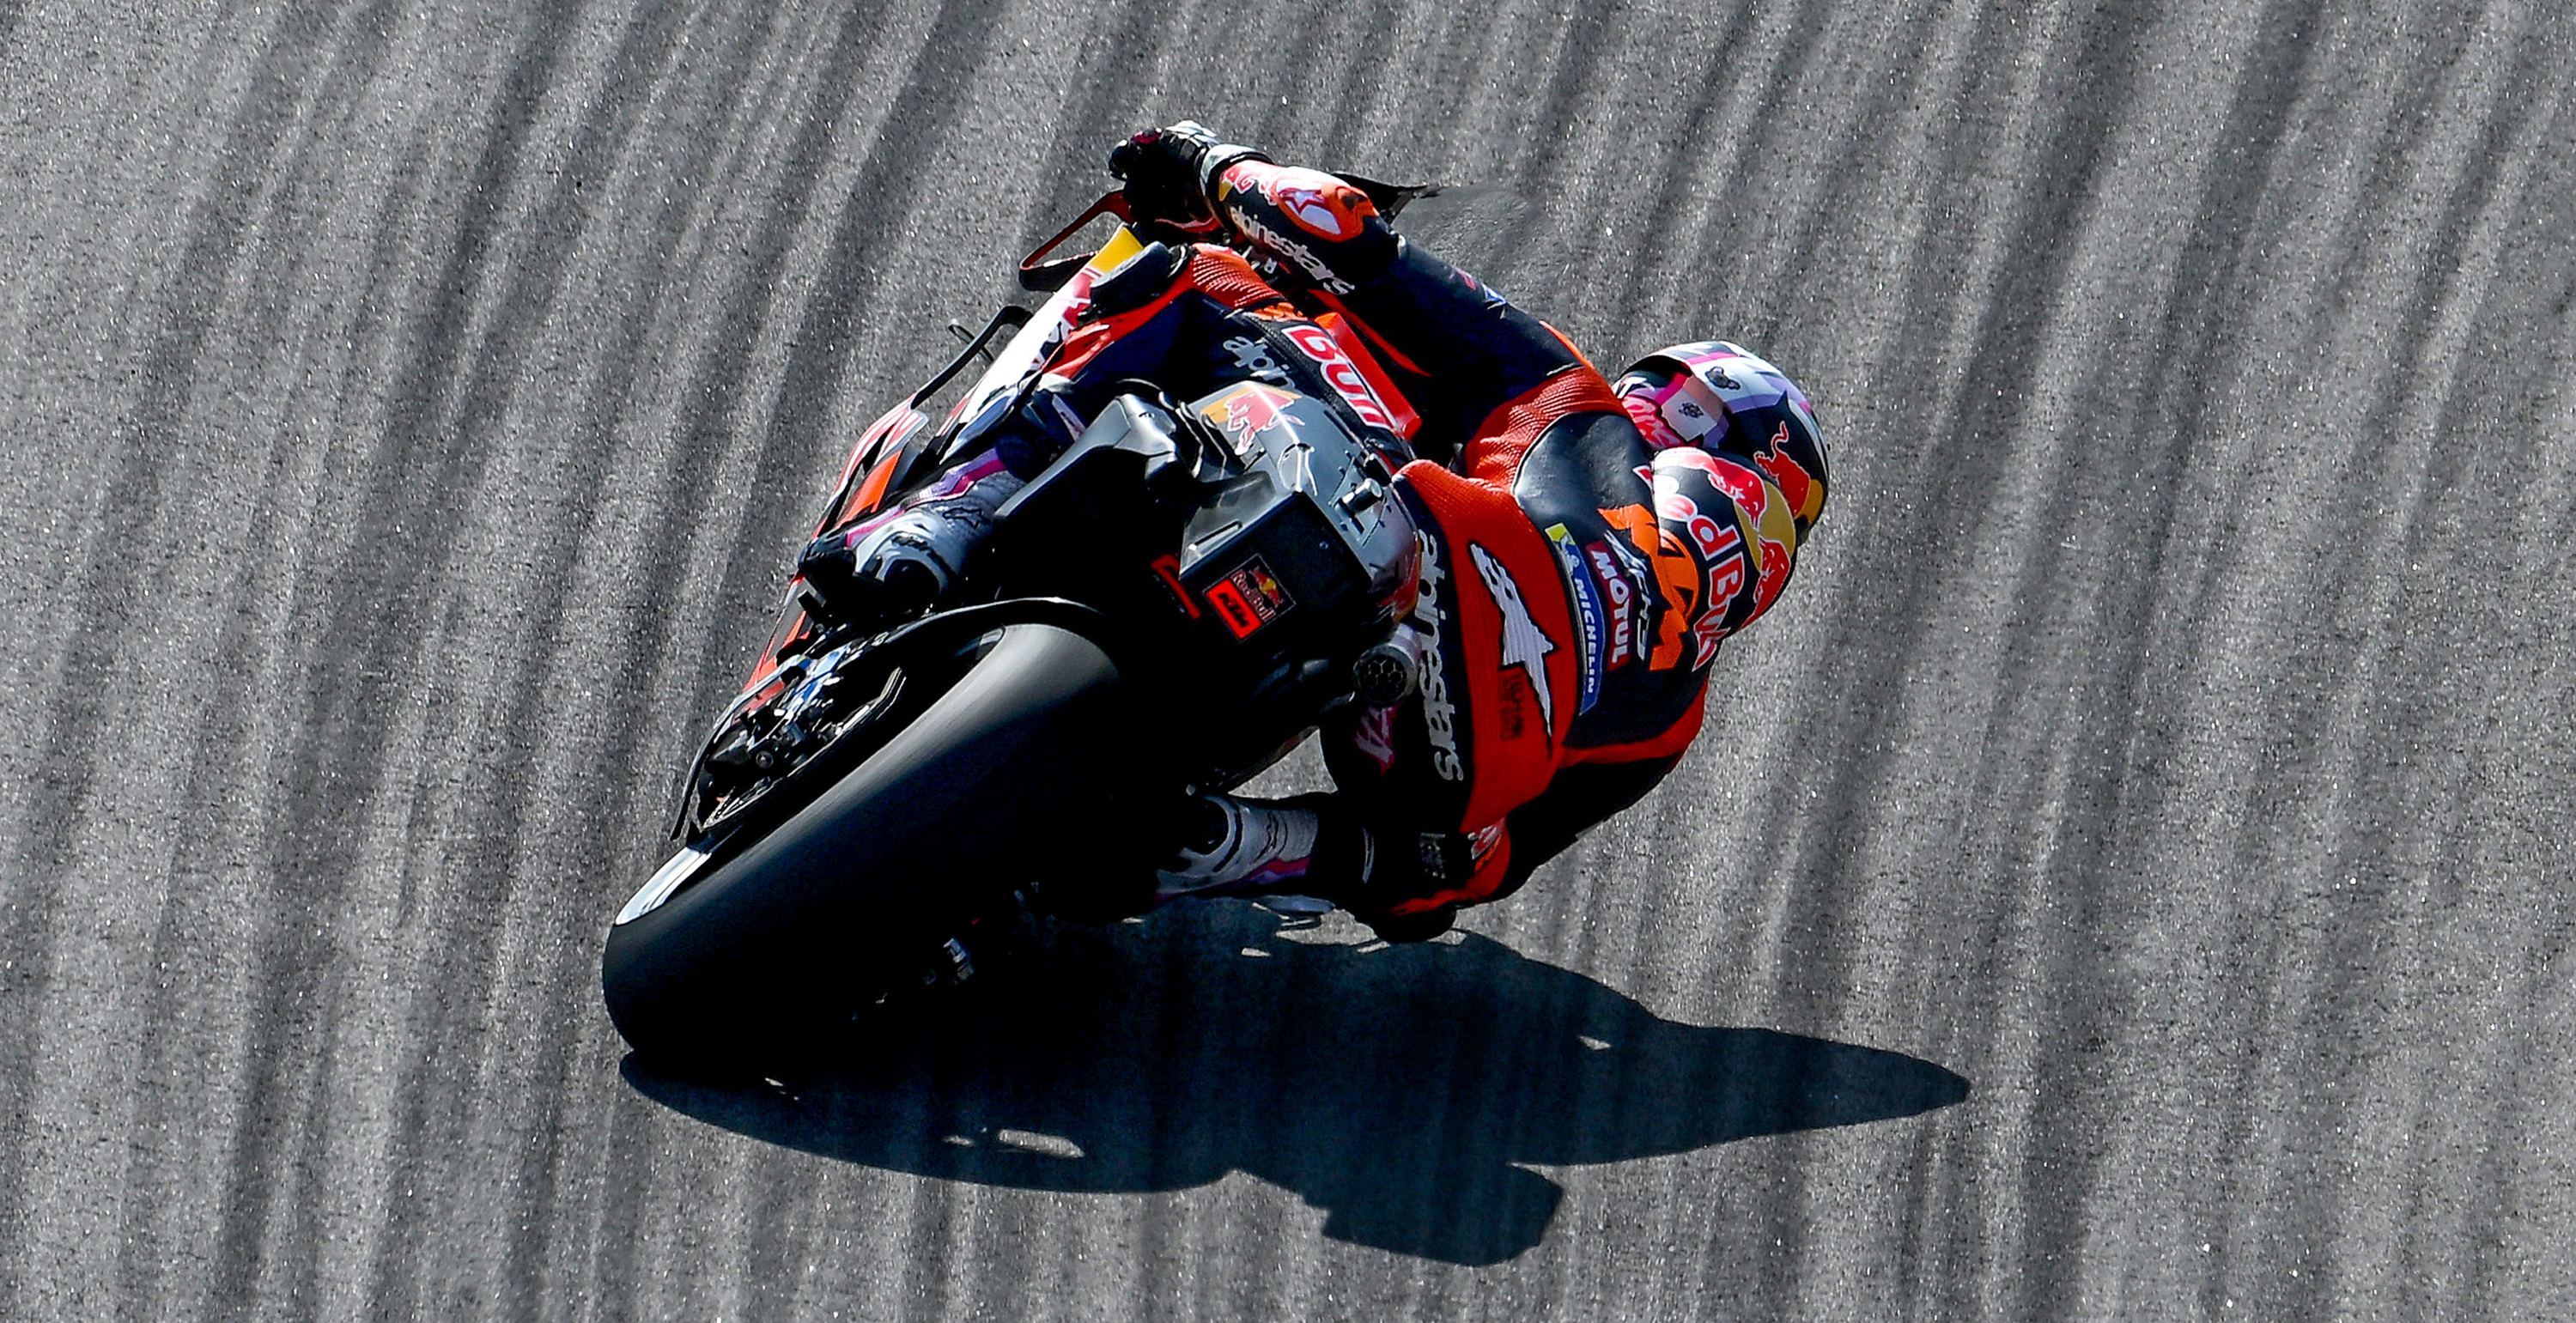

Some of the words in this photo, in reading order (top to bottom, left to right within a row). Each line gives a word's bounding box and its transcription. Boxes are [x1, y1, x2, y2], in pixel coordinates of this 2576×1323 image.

[1230, 205, 1355, 295] alpinestars
[1230, 568, 1259, 601] Red
[1249, 593, 1277, 622] Bull
[1575, 579, 1597, 693] MICHELIN
[1591, 550, 1631, 663] MOTUL
[1415, 529, 1463, 780] alpinestars
